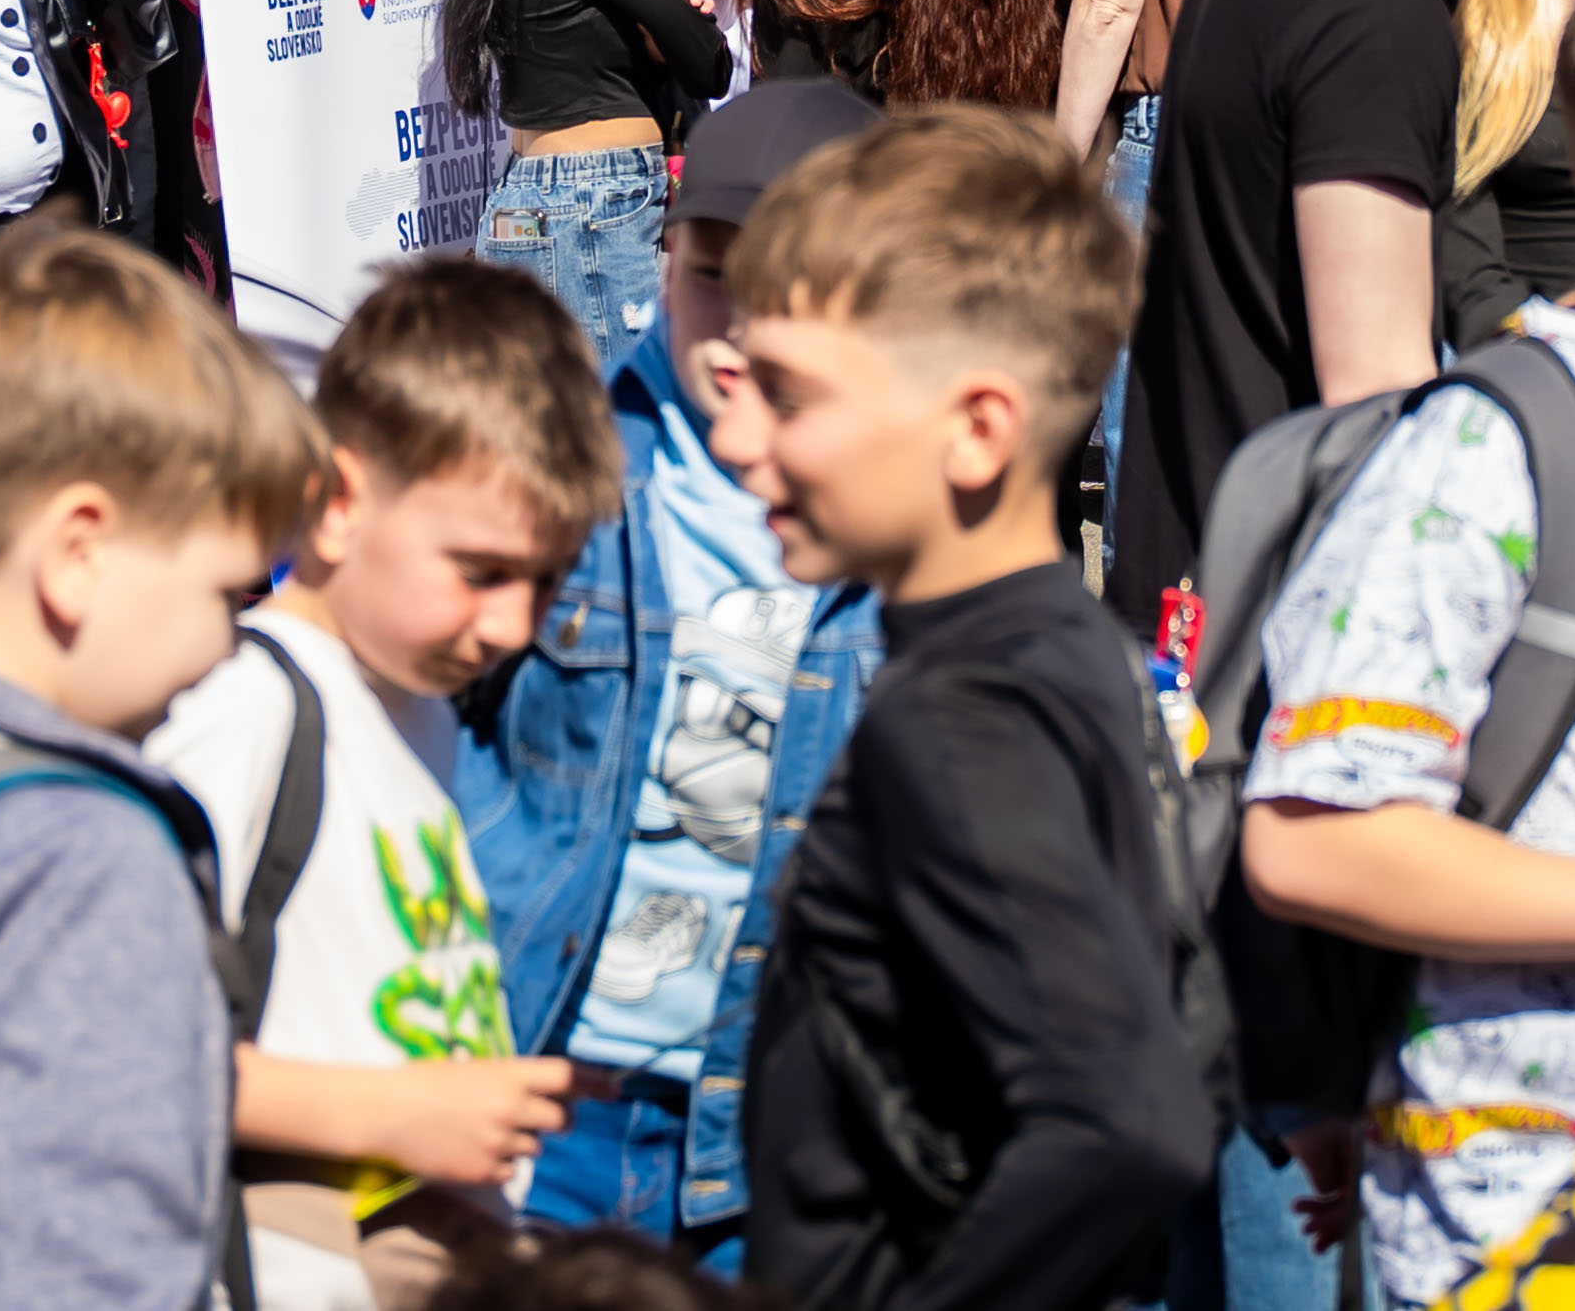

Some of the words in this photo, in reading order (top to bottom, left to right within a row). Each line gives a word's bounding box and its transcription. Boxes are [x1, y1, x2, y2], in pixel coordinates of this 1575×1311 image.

[287, 12, 293, 33] A
[267, 30, 323, 62] SLOVENSKO
[398, 188, 486, 253] SLOVENSK
